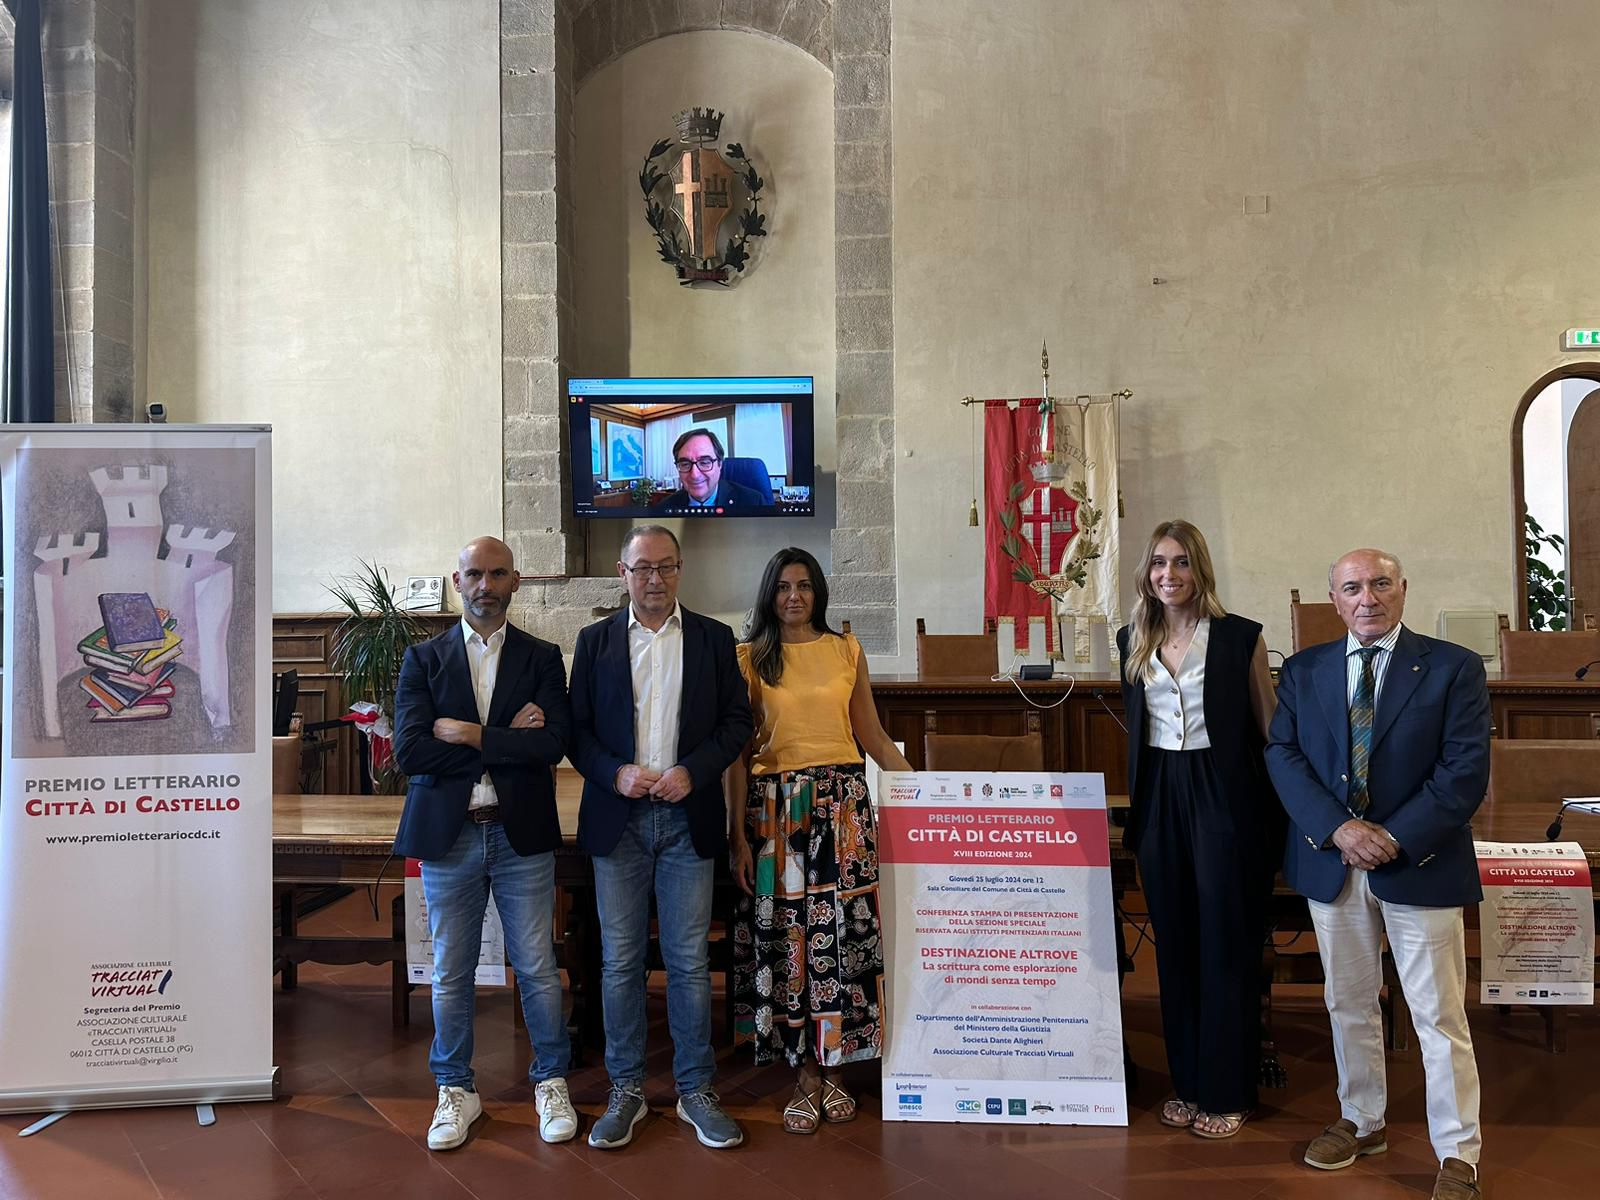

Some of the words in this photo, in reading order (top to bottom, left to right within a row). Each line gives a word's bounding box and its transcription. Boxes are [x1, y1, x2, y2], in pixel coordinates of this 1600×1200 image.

[1028, 425, 1071, 437] CONE
[25, 778, 106, 793] PREMIO
[114, 774, 240, 790] LETTERARIO
[25, 797, 96, 816] CITTÀ
[104, 800, 126, 814] DI
[136, 795, 240, 813] CASTELLO
[928, 814, 974, 824] PREMIO
[978, 814, 1054, 824] LETTERARIO
[46, 830, 221, 845] www.premioletterariocdc.it
[908, 826, 961, 842] CITTÀ
[966, 830, 984, 842] DI
[988, 830, 1078, 844] CASTELLO
[974, 850, 1013, 858] EDIZIONE
[1489, 868, 1518, 876] CITTÀ
[1520, 868, 1528, 876] DI
[1530, 869, 1576, 877] CASTELLO
[985, 876, 1004, 884] luglio
[949, 918, 974, 926] DELLA
[921, 948, 1016, 959] DESTINAZIONE
[1020, 950, 1078, 960] ALTROVE
[90, 962, 134, 970] ASSOCIAZIONE
[922, 962, 934, 970] La
[937, 962, 980, 971] scrittura
[982, 964, 1010, 972] come
[1013, 964, 1078, 974] esplorazione
[944, 976, 954, 984] di
[956, 976, 988, 984] mondi
[991, 977, 1020, 985] senza
[1022, 978, 1056, 988] tempo
[84, 1005, 130, 1015] Segreteria
[132, 1004, 146, 1012] del
[148, 1003, 181, 1012] Premio
[77, 1017, 139, 1026] ASSOCIAZIONE
[140, 1015, 188, 1024] CULTURALE
[916, 1014, 964, 1022] Dipartimento
[966, 1024, 1000, 1032] Ministero
[91, 1038, 127, 1047] CASELLA
[129, 1037, 164, 1045] POSTALE
[962, 1036, 988, 1044] Società
[990, 1036, 1012, 1044] Dante
[70, 1050, 92, 1058] 06012
[122, 1047, 131, 1055] DI
[133, 1045, 175, 1055] CASTELLO
[177, 1044, 194, 1054] (PG)
[933, 1048, 978, 1056] Associazione
[980, 1048, 1013, 1056] Culturale
[956, 1101, 980, 1110] CMC
